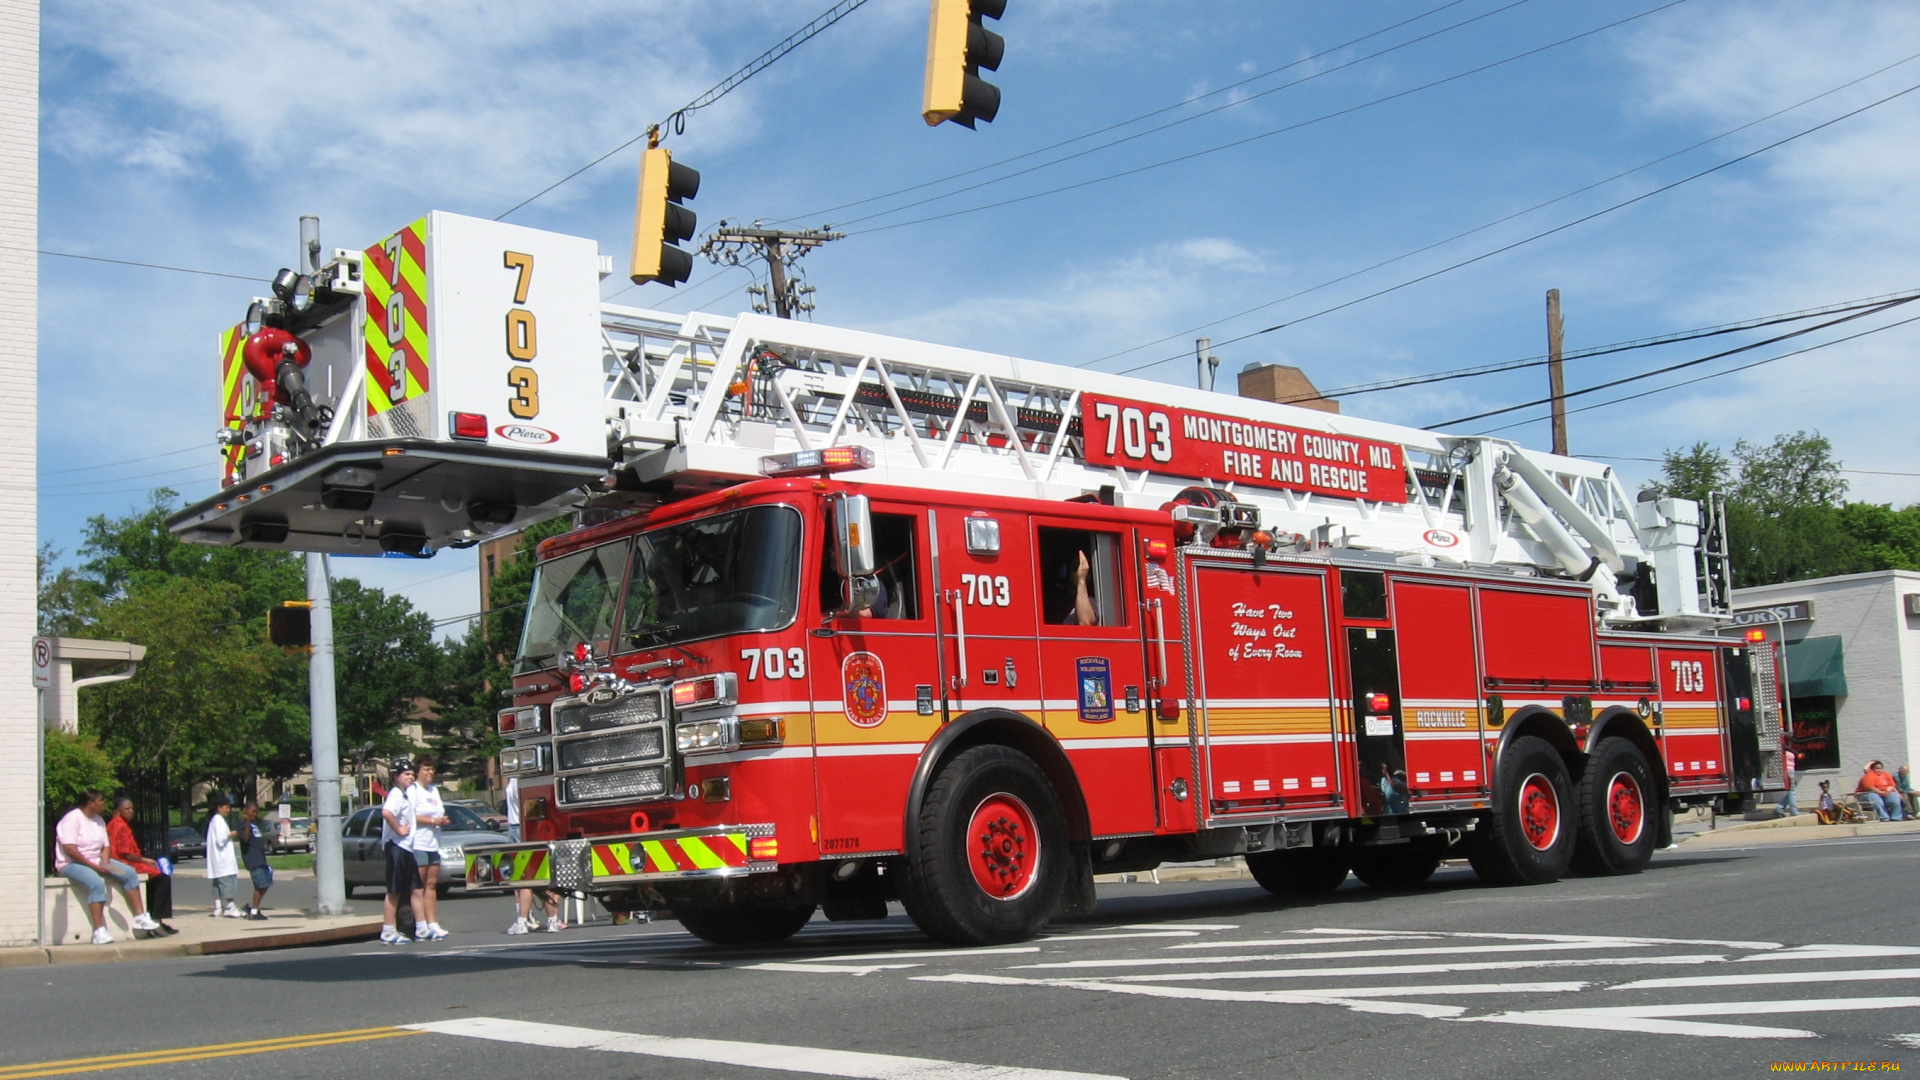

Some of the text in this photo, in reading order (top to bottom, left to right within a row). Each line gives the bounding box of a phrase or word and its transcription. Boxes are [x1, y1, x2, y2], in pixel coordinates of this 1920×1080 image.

[385, 233, 406, 404] 703
[504, 250, 540, 420] 703
[507, 424, 546, 440] Pierce
[1095, 402, 1173, 463] 703
[1183, 414, 1397, 470] MONTGOMERY COUNTY, MD.
[1223, 450, 1369, 493] FIRE AND RESCUE
[961, 573, 1010, 607] 703
[1231, 602, 1294, 619] Have Two
[1231, 622, 1297, 641] Ways Out
[740, 646, 806, 681] 703
[1228, 642, 1303, 662] of Every Room
[1670, 660, 1704, 693] 703
[1416, 710, 1466, 728] ROCKVILLE
[824, 838, 860, 849] 2077878
